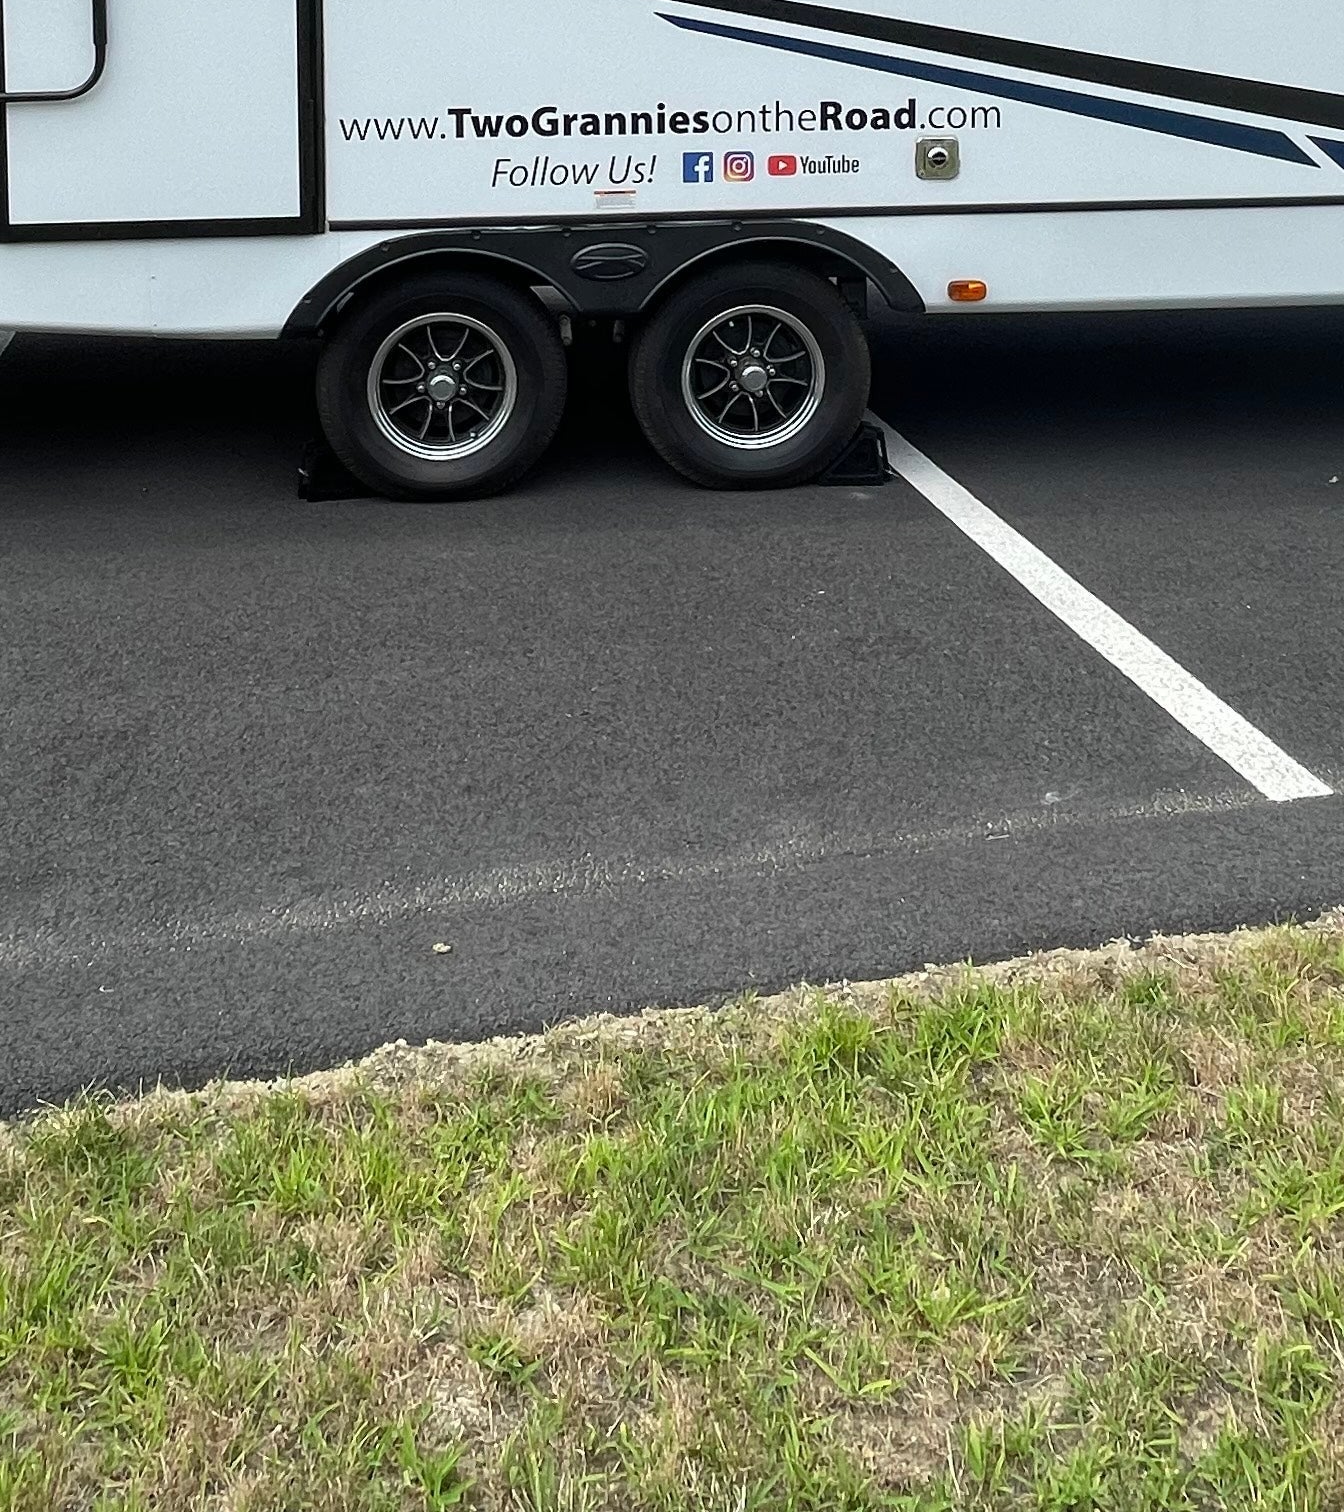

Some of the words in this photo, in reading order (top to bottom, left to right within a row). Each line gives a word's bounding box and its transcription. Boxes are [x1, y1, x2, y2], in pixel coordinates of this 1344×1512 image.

[339, 99, 1002, 142] www.TwoGranniesontheRoad.com
[491, 156, 600, 188] Follow
[608, 155, 657, 185] Us!
[800, 155, 860, 174] YouTube
